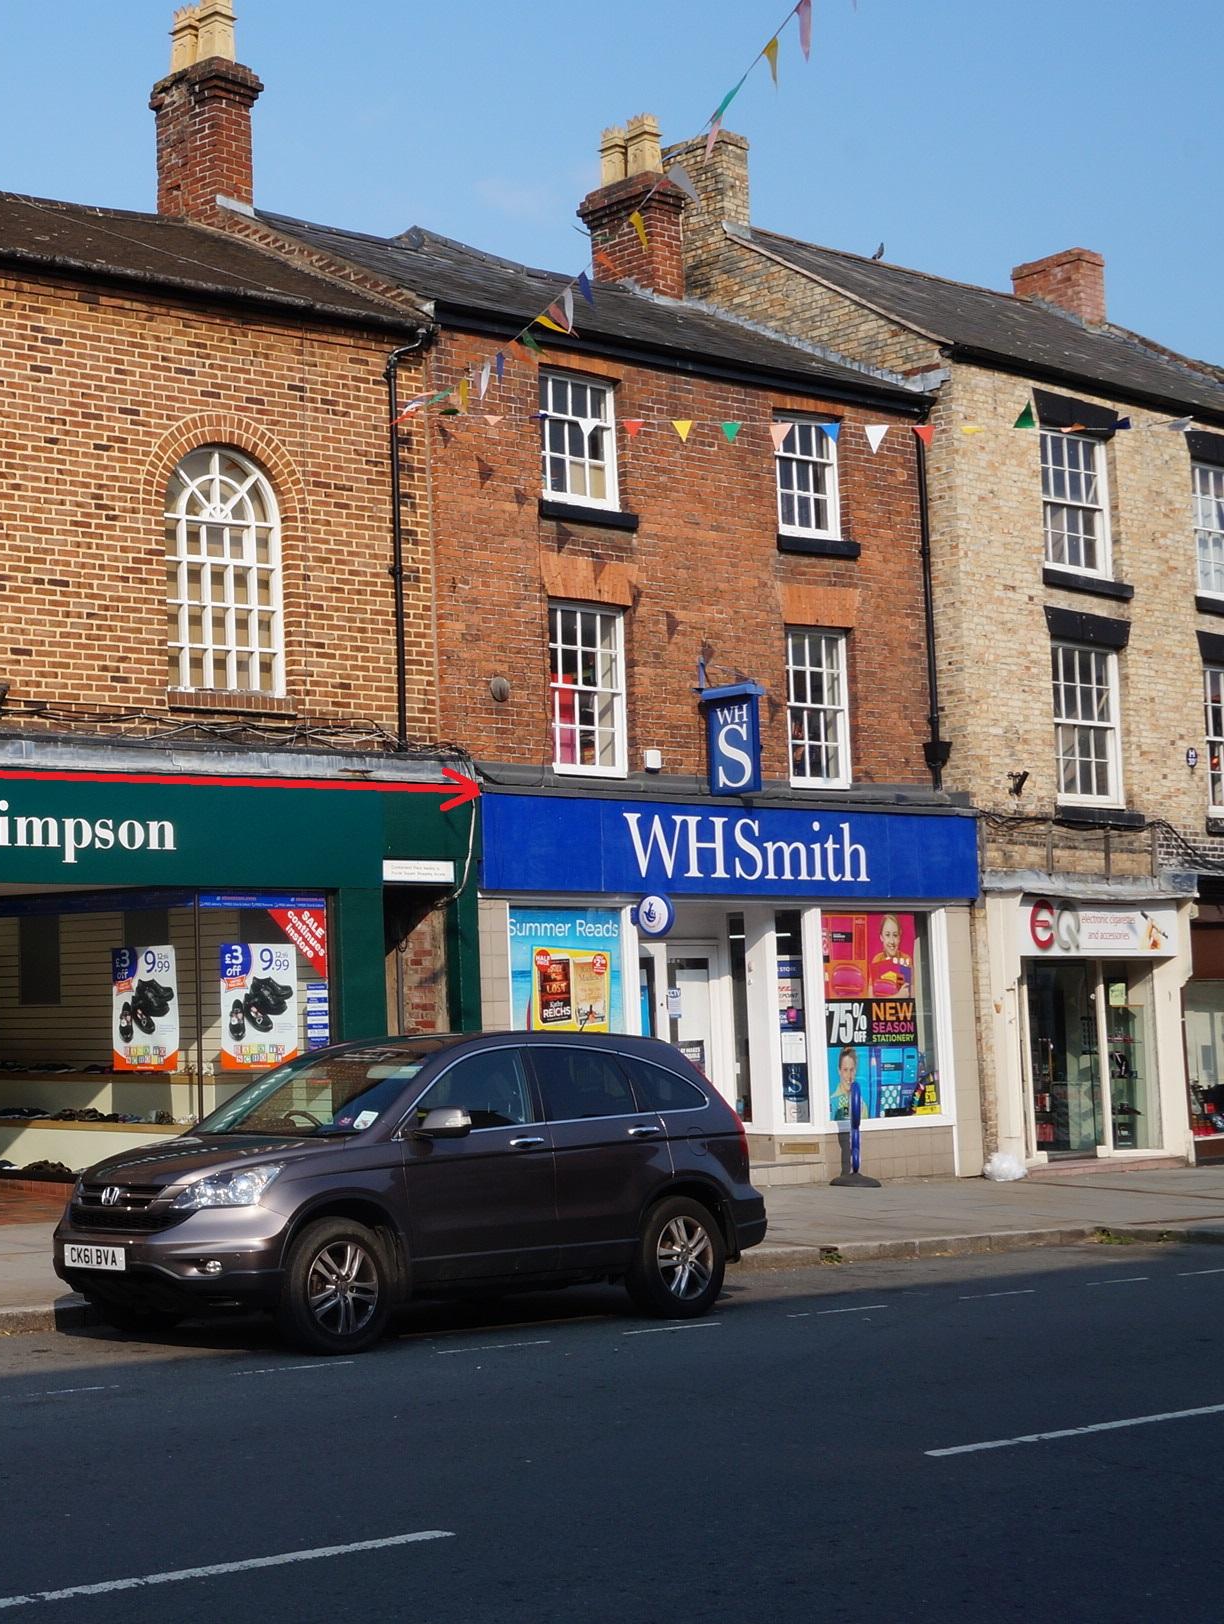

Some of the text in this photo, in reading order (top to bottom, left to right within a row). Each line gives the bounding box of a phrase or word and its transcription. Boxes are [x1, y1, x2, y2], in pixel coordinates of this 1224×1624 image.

[716, 704, 748, 725] WH
[718, 723, 752, 787] S
[622, 812, 871, 882] WHSmith
[287, 910, 325, 957] continues
[302, 910, 325, 939] SALE
[507, 919, 619, 937] Summer Reads
[286, 923, 314, 958] instore
[144, 950, 170, 973] 9.99
[225, 945, 243, 964] £3
[259, 948, 290, 971] 9.99
[226, 966, 242, 976] off
[543, 1006, 571, 1018] REICHS
[872, 1002, 914, 1021] NEW
[829, 1002, 867, 1044] 75%
[872, 1022, 914, 1033] SEASON
[854, 1031, 867, 1043] OFF
[872, 1034, 915, 1042] STATIONERY
[71, 1247, 117, 1266] CK61 BVA
